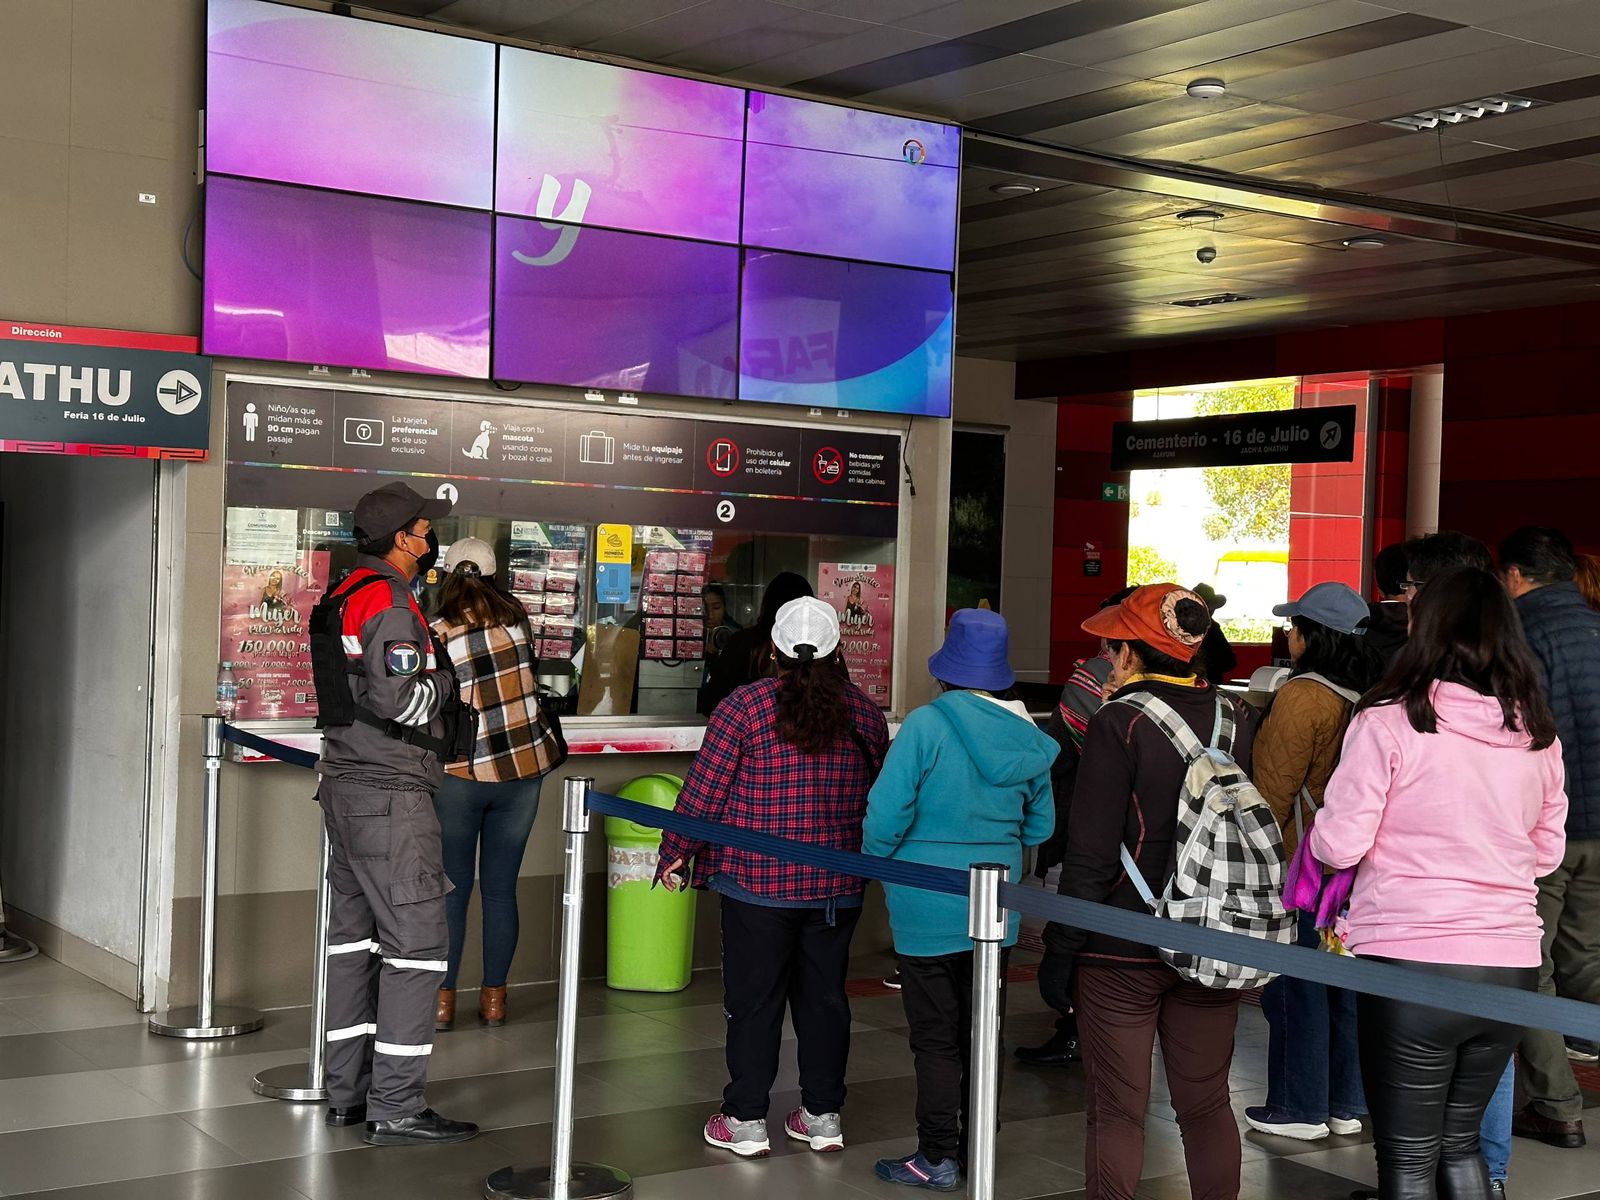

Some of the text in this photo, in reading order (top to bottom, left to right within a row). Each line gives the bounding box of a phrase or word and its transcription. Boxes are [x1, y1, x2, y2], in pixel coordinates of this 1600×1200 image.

[511, 173, 592, 266] y
[11, 326, 62, 338] Dirección
[0, 361, 132, 406] ATHU
[268, 404, 299, 414] Niño/as
[64, 410, 146, 423] Feria 16 de Julio
[267, 415, 293, 423] midan
[294, 416, 311, 425] más
[391, 415, 428, 425] La tarjeta
[267, 424, 279, 432] 90
[295, 427, 320, 436] pagan
[391, 426, 438, 436] preferencial
[502, 423, 521, 432] Viaja
[536, 426, 545, 434] tu
[267, 435, 293, 444] pasaje
[401, 436, 412, 444] de
[413, 437, 428, 445] uso
[502, 434, 534, 442] mascota
[1126, 432, 1208, 450] Cementerio
[1223, 429, 1242, 446] 16
[1246, 427, 1266, 444] de
[1270, 425, 1310, 443] Julio
[391, 445, 426, 454] exclusivo
[502, 444, 553, 454] usando correa
[623, 442, 683, 455] Mide tu equipaje
[746, 447, 776, 457] Prohibido
[501, 453, 507, 462] y
[508, 453, 528, 461] bozal
[622, 453, 684, 464] antes de ingresar
[858, 453, 885, 461] consumir
[769, 459, 792, 467] celular
[719, 503, 731, 518] 2
[302, 528, 331, 536] Descarga
[249, 601, 302, 627] Mujer
